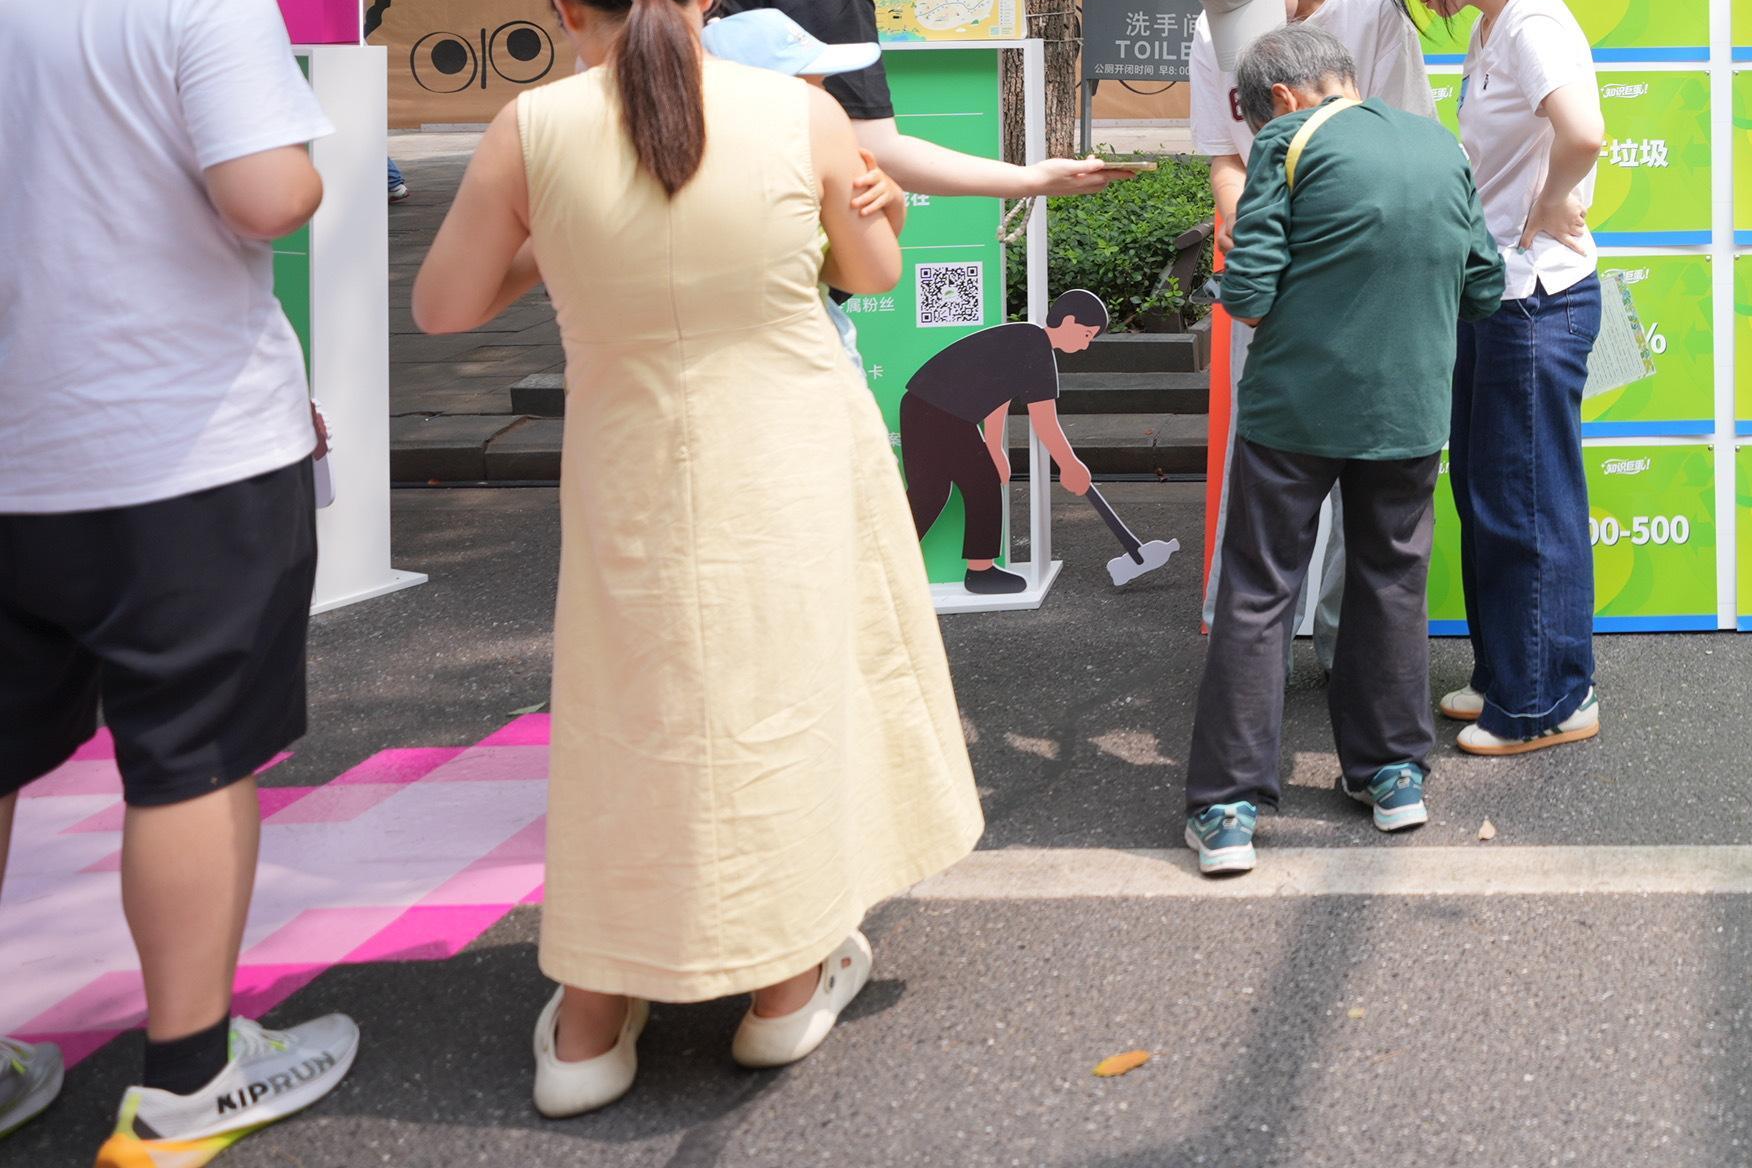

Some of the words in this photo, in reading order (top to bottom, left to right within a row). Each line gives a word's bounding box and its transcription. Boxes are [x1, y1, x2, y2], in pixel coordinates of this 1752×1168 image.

[1126, 11, 1199, 37] 洗手间
[1115, 40, 1192, 60] TOILE
[868, 364, 884, 380] 卡
[216, 1051, 336, 1115] KIPRUN
